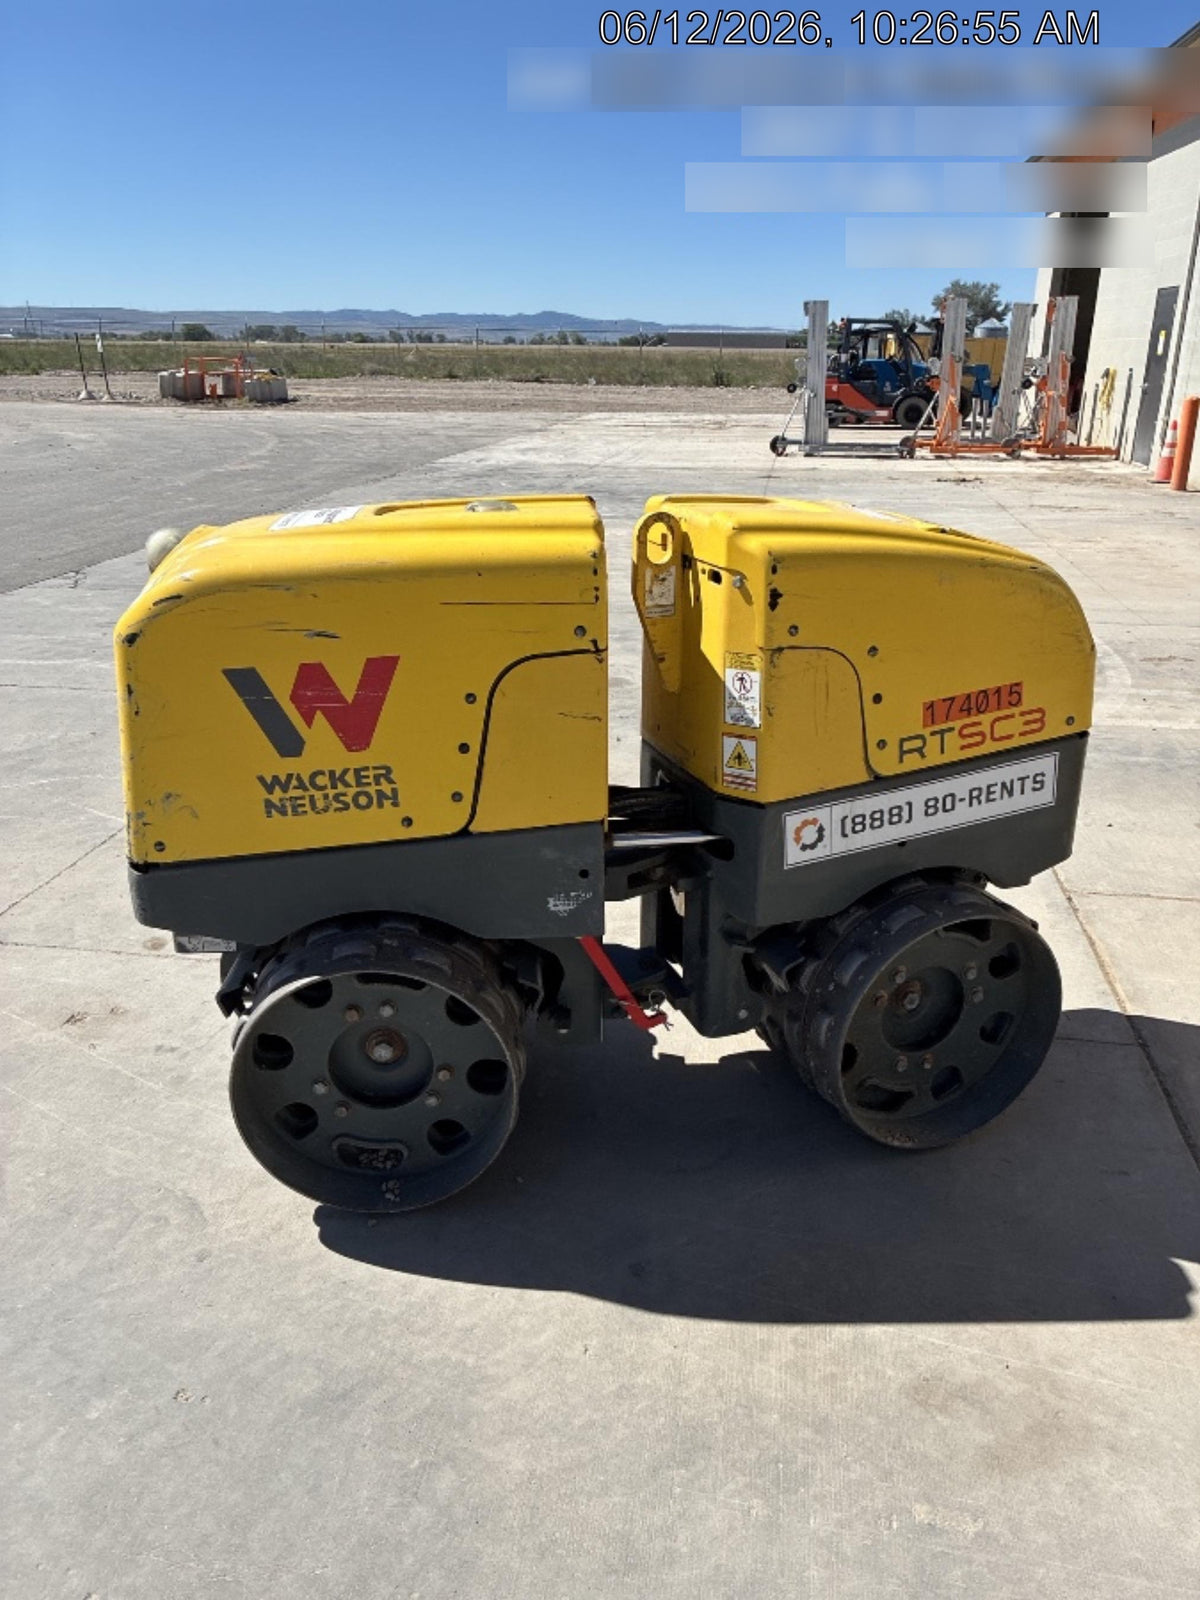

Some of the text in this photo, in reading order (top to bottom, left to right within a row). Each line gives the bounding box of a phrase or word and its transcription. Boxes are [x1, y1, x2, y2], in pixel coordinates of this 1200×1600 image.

[924, 684, 1023, 726] 174015
[898, 706, 1047, 764] RTSC3
[256, 764, 397, 796] WACKER
[262, 786, 401, 818] NEUSON
[840, 771, 1047, 839] (888) 80-RENTS
